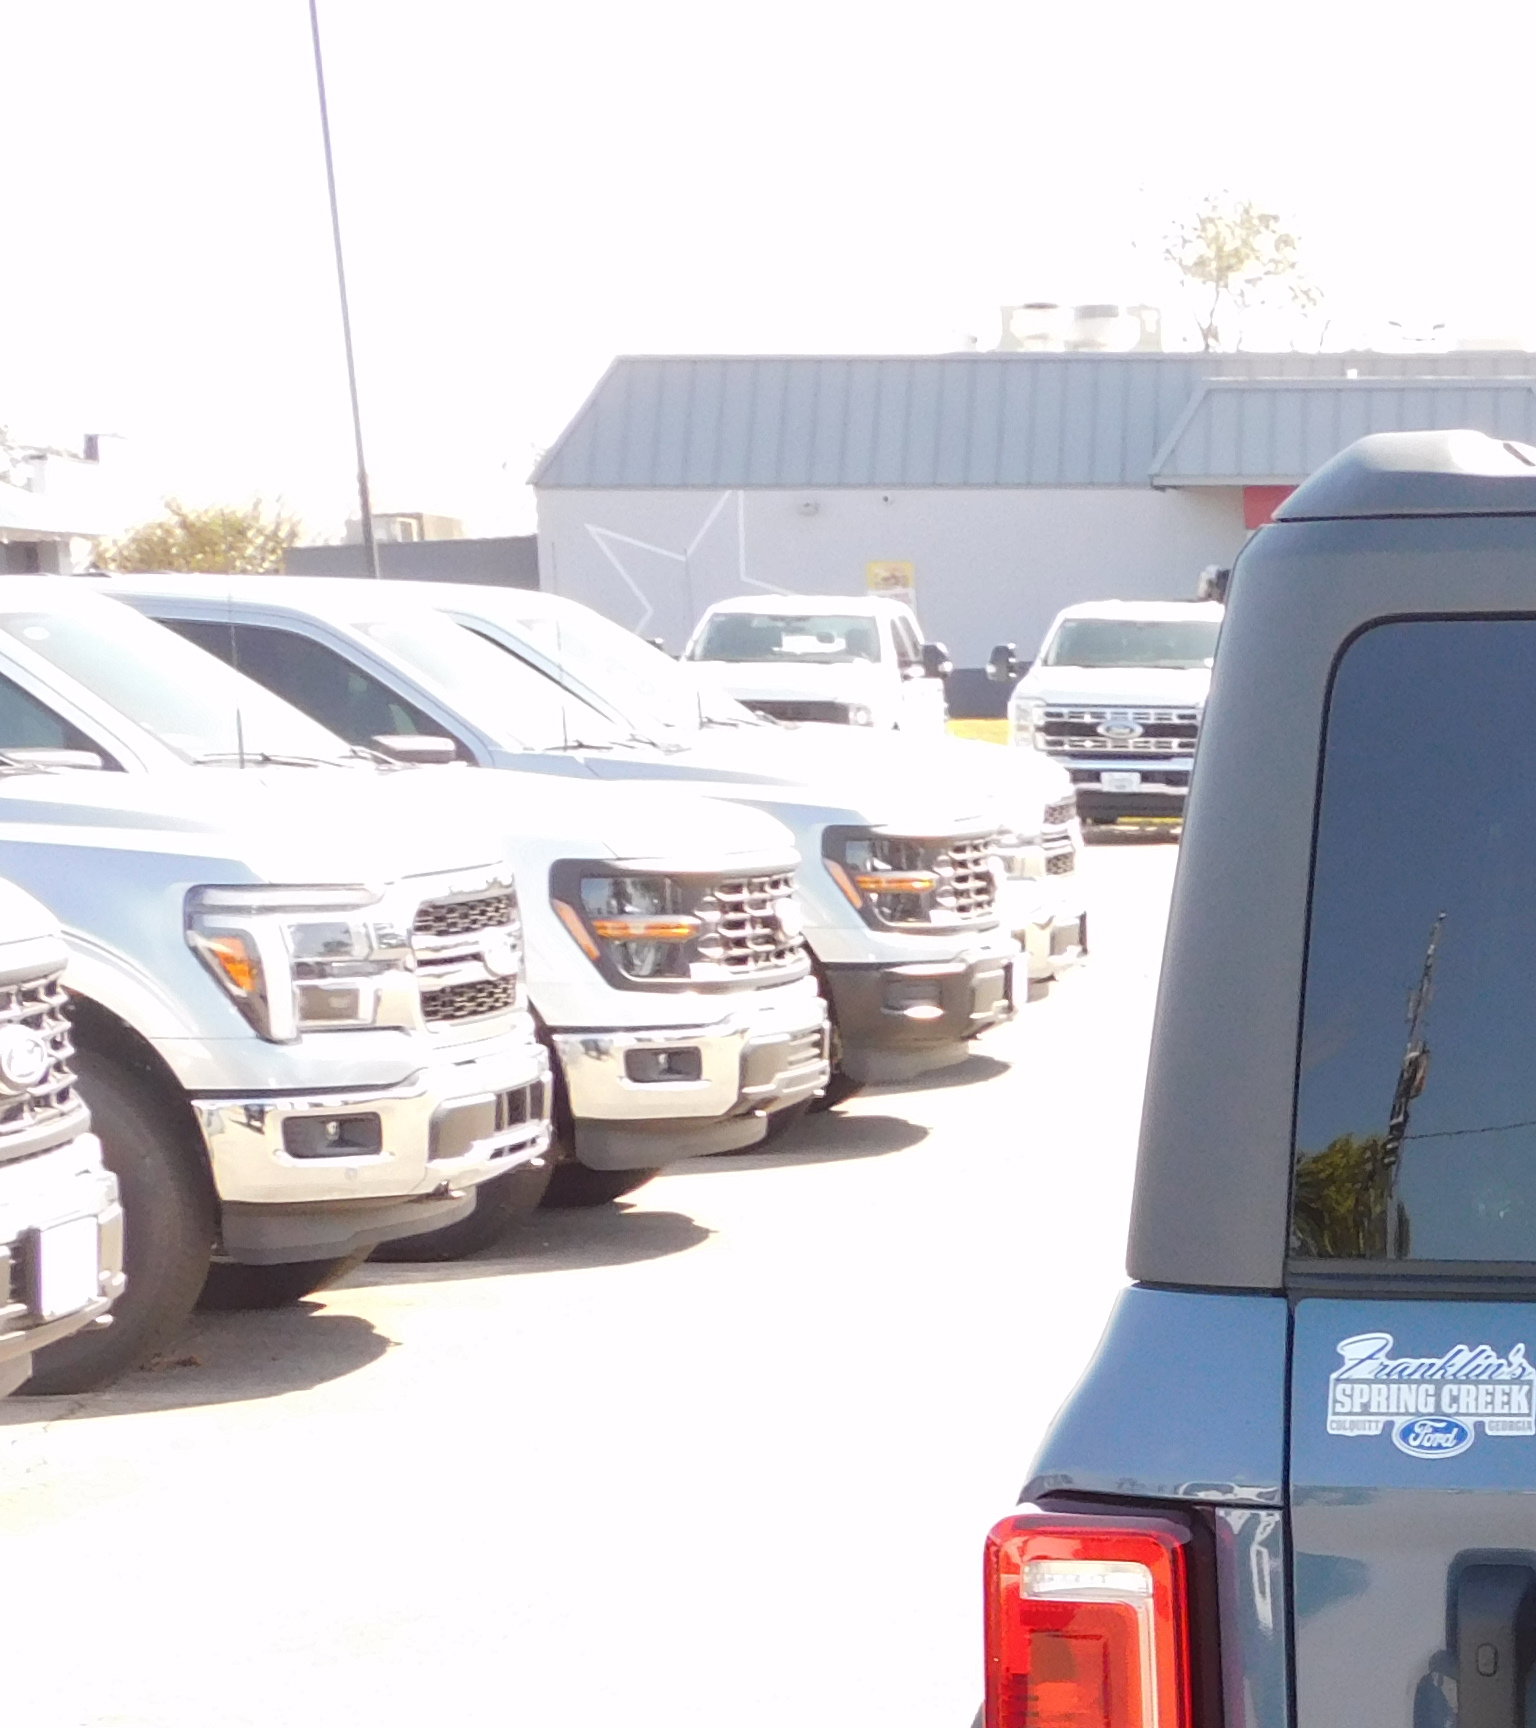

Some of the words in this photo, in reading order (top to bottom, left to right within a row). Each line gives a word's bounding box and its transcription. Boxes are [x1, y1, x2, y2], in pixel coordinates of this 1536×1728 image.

[1337, 1335, 1531, 1380] Franklin's
[1335, 1384, 1436, 1414] SPRING
[1441, 1384, 1530, 1414] CREEK
[1408, 1420, 1459, 1447] Ford
